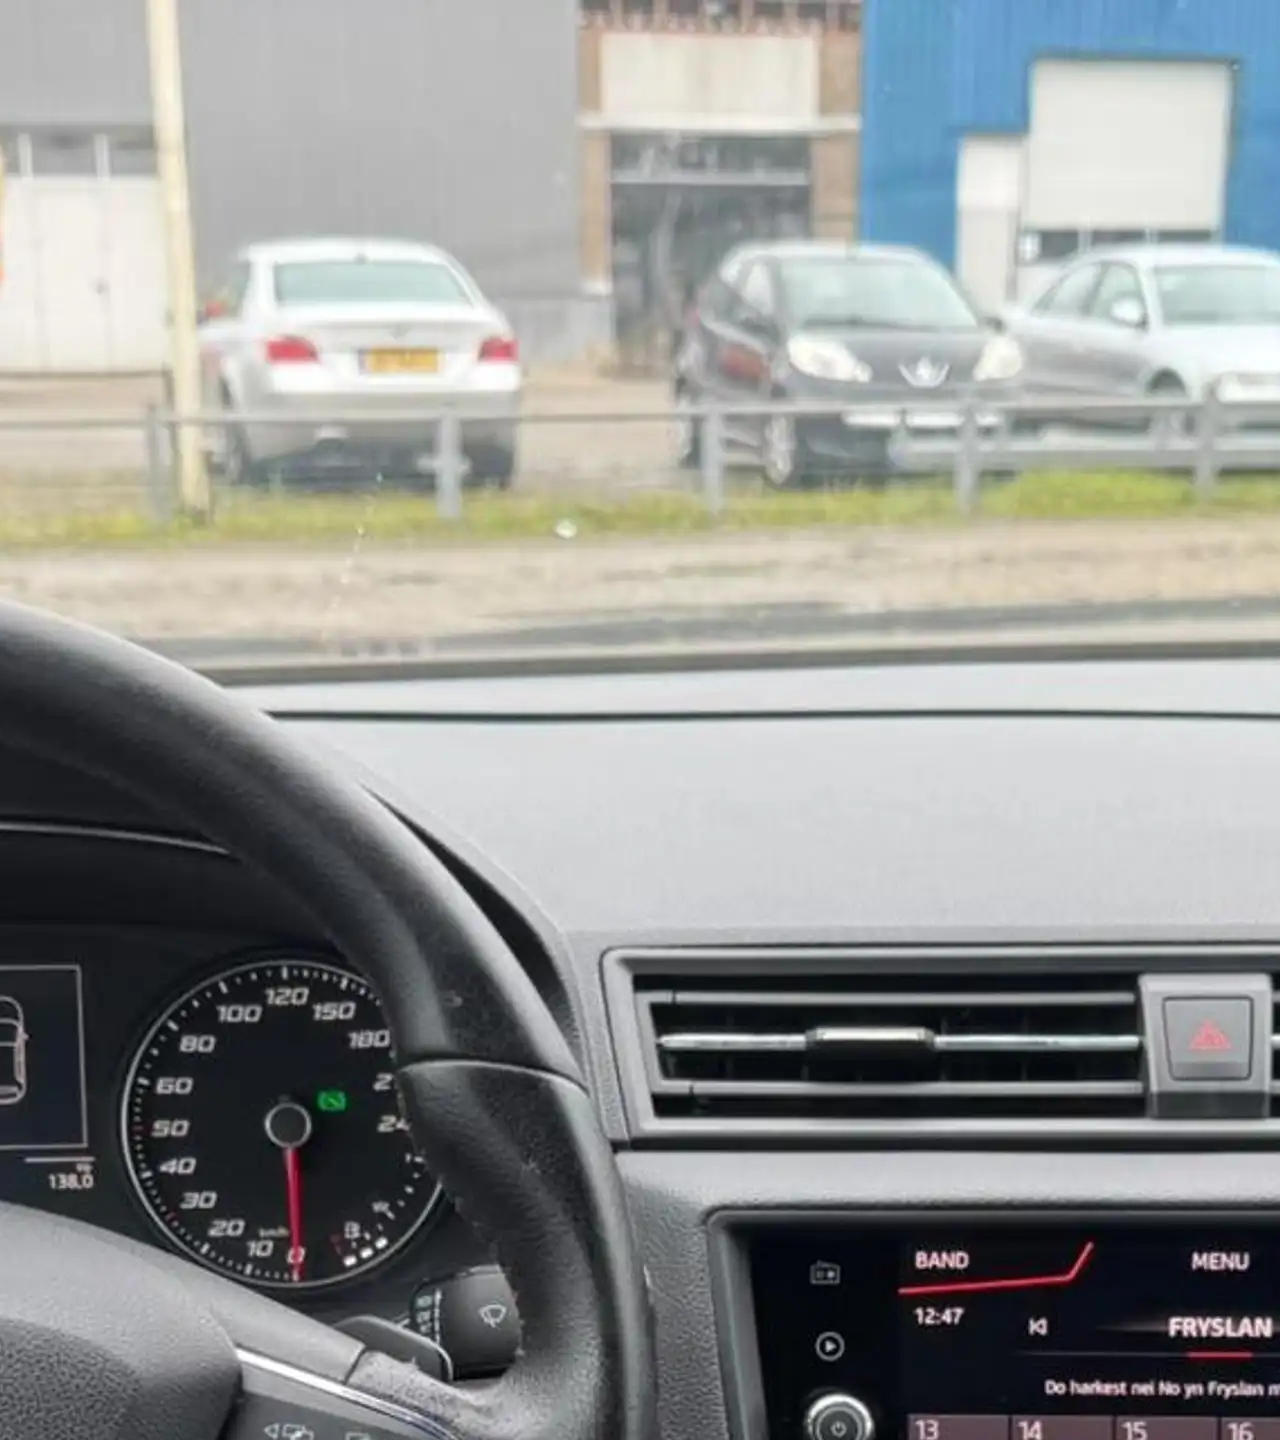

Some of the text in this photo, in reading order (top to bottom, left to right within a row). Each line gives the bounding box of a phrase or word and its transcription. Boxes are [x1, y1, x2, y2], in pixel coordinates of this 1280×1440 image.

[266, 988, 309, 1005] 120
[217, 1005, 262, 1022] 100
[314, 1002, 356, 1020] 150
[180, 1036, 215, 1052] 80
[348, 1029, 391, 1050] 180
[156, 1078, 192, 1094] 60
[152, 1120, 189, 1136] 50
[160, 1158, 196, 1174] 40
[181, 1192, 217, 1208] 30
[209, 1220, 245, 1236] 20
[248, 1240, 273, 1256] 10
[286, 1247, 306, 1264] 0
[916, 1251, 968, 1269] BAND
[1192, 1253, 1249, 1270] MENU
[916, 1308, 963, 1324] 12:47
[1168, 1317, 1273, 1337] FRYSLAN
[1045, 1380, 1066, 1394] Do
[1070, 1381, 1126, 1395] harkest
[1131, 1382, 1154, 1395] nei
[1159, 1381, 1180, 1395] No
[1184, 1384, 1203, 1398] yn
[1208, 1381, 1264, 1398] Fryslan
[916, 1420, 938, 1440] 13
[1020, 1421, 1042, 1440] 14
